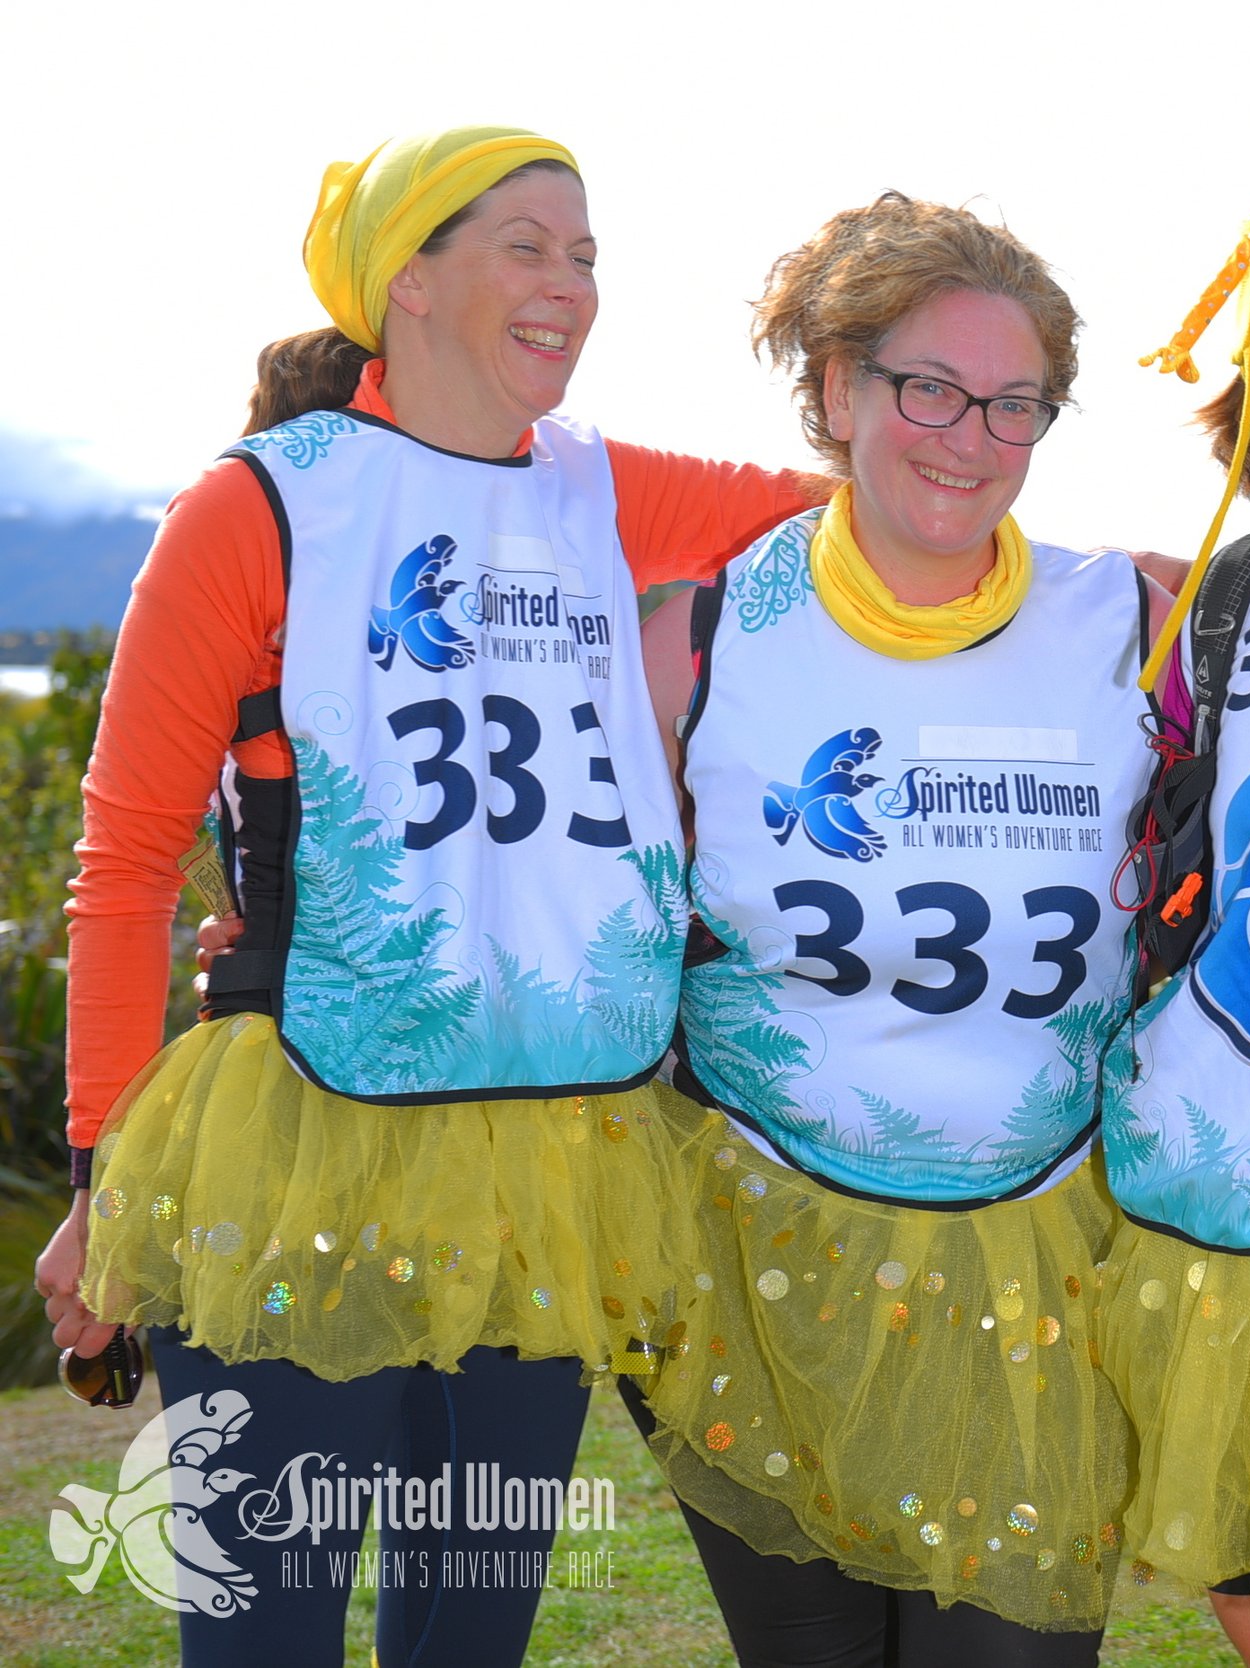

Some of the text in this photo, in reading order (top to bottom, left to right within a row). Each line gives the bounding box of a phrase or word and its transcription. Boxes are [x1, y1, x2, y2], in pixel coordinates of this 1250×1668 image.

[459, 573, 559, 631] Spirited
[491, 636, 547, 663] WOMEN'S
[874, 766, 1101, 822] Spirited Women
[903, 824, 1103, 853] ALL WOMEN'S ADVENTURE RACE
[772, 879, 1101, 1020] 333
